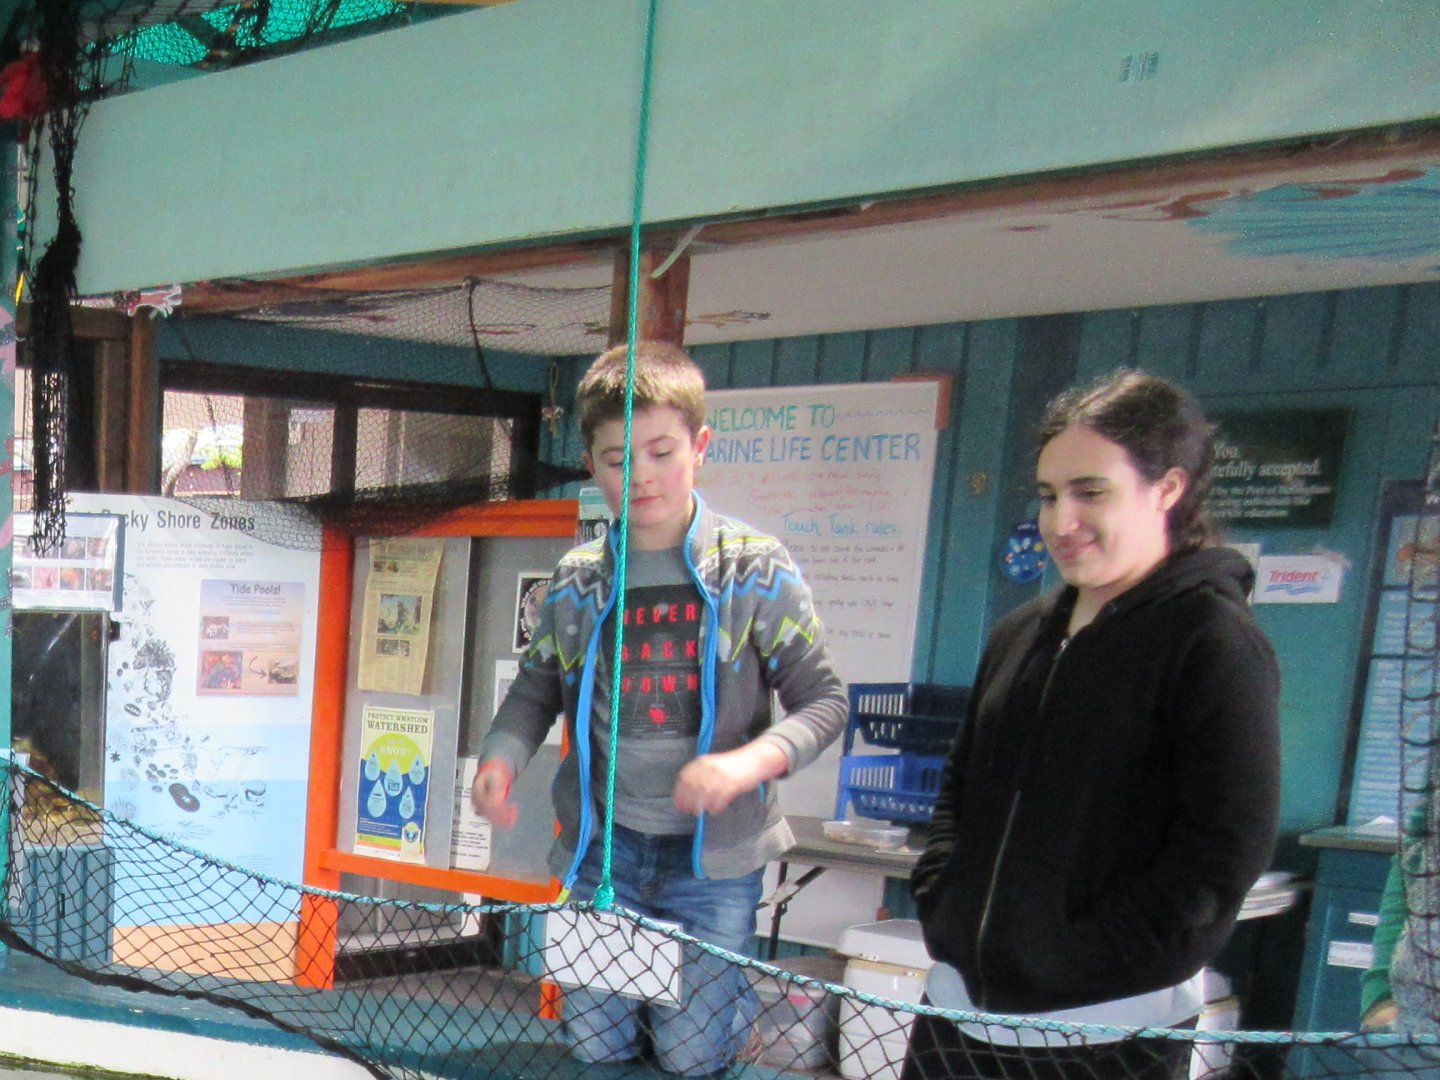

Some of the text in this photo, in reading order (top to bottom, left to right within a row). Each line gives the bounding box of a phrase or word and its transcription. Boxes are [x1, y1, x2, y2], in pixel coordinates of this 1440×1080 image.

[807, 404, 836, 428] TO
[703, 434, 921, 463] ARINE LIFE CENTER
[157, 509, 201, 530] Shore
[210, 511, 256, 531] Zones
[781, 512, 823, 537] Touch
[1269, 571, 1320, 583] Trident
[230, 583, 281, 595] Tide Pools!
[367, 712, 429, 724] PROTECT WHATCOM
[367, 720, 428, 735] WATERSHED
